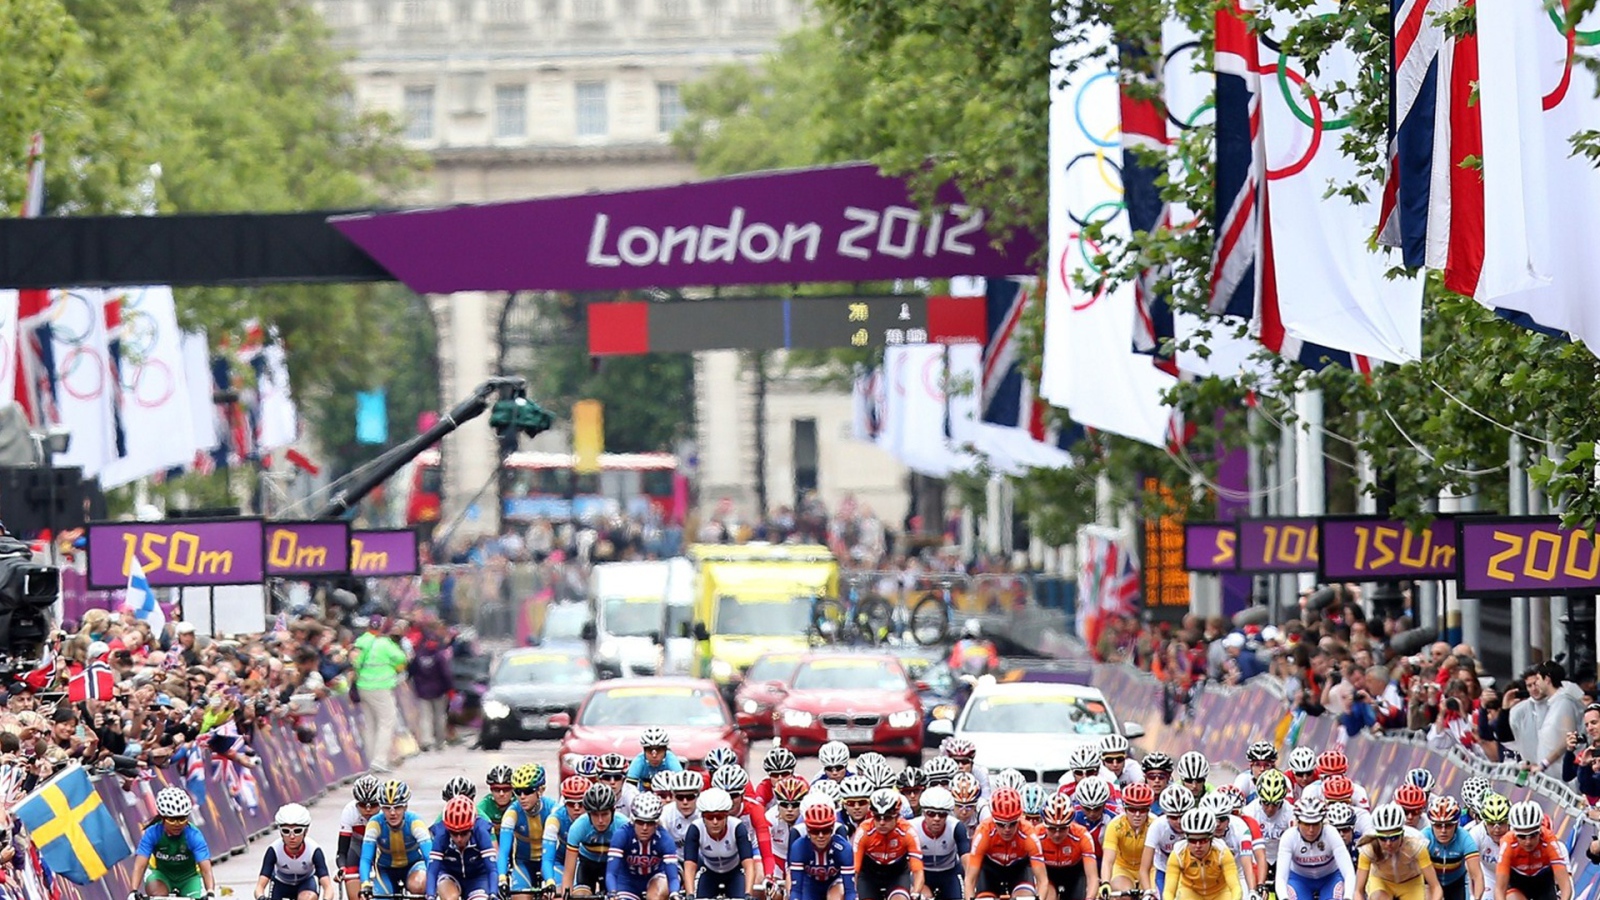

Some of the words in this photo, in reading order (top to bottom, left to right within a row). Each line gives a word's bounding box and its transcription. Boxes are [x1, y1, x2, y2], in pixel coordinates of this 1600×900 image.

[586, 206, 822, 267] London
[837, 204, 985, 260] 2012
[121, 531, 233, 576] 150m
[268, 529, 328, 568] 0m
[626, 855, 661, 867] USA
[804, 865, 840, 876] USA
